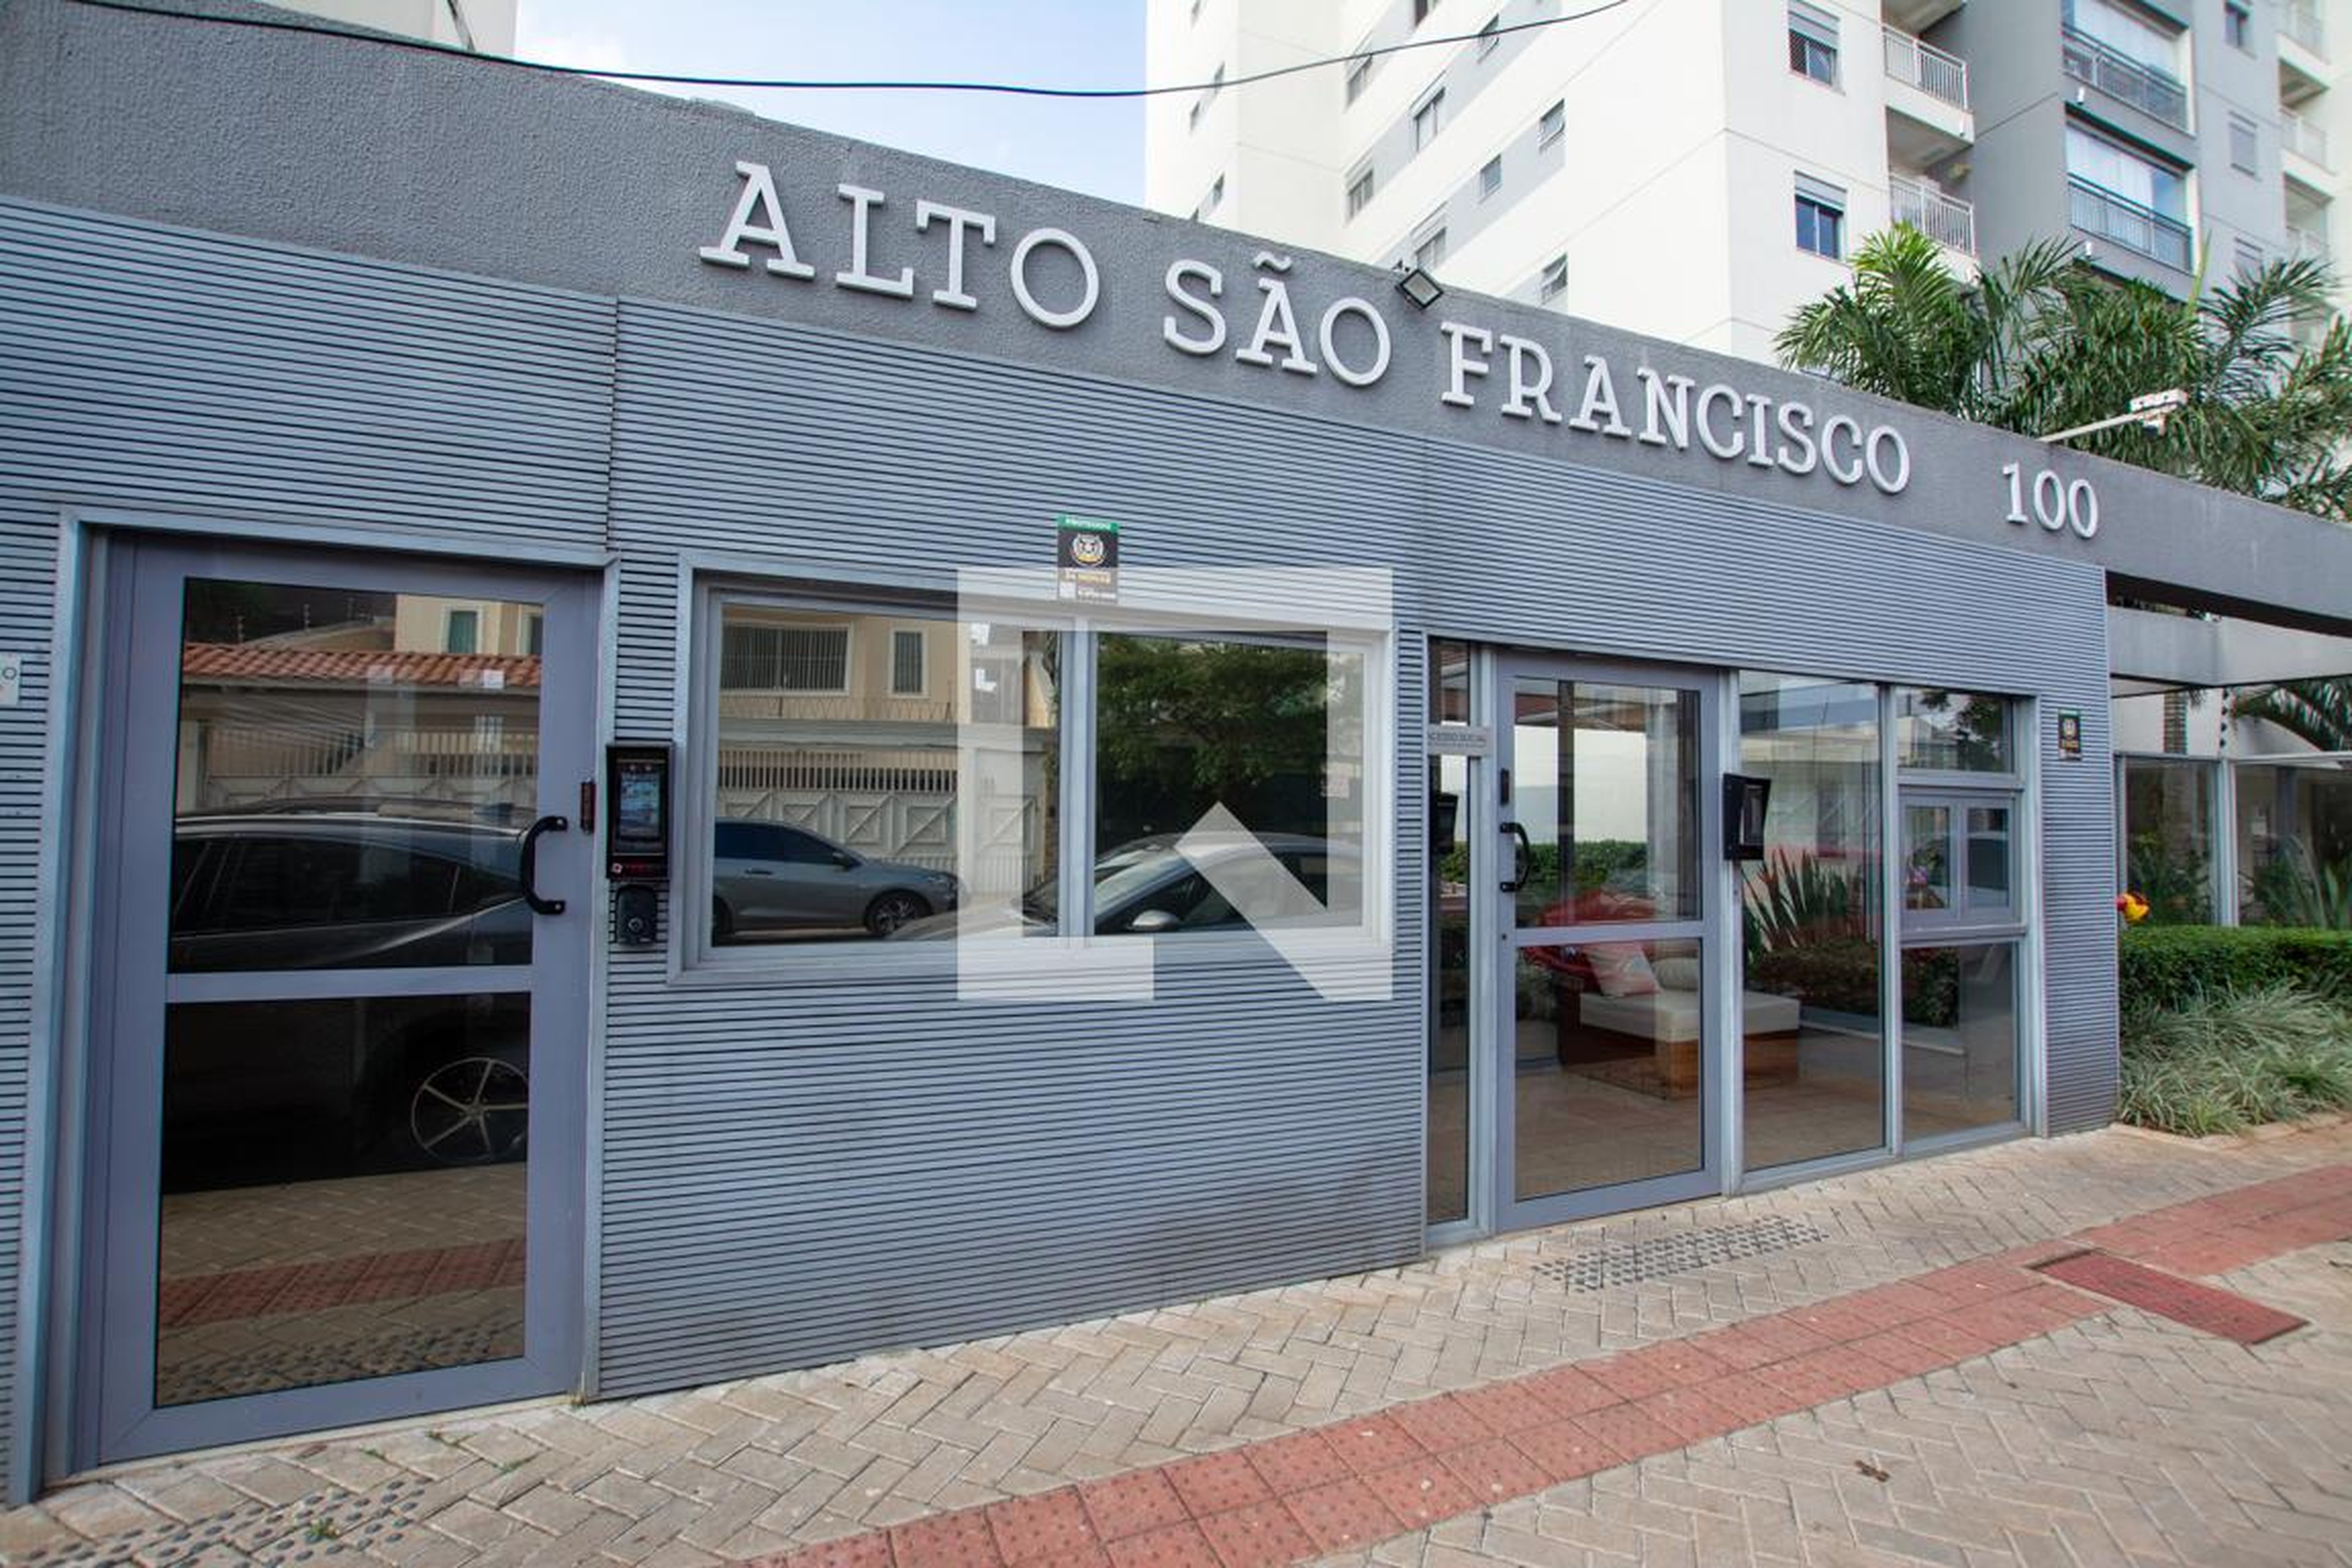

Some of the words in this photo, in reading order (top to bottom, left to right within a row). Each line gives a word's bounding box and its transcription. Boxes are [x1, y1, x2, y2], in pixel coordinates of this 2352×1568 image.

[699, 161, 1100, 328] ALTO
[1164, 252, 1392, 385] SÃO
[1441, 322, 1911, 494] FRANCISCO
[2003, 462, 2098, 538] 100
